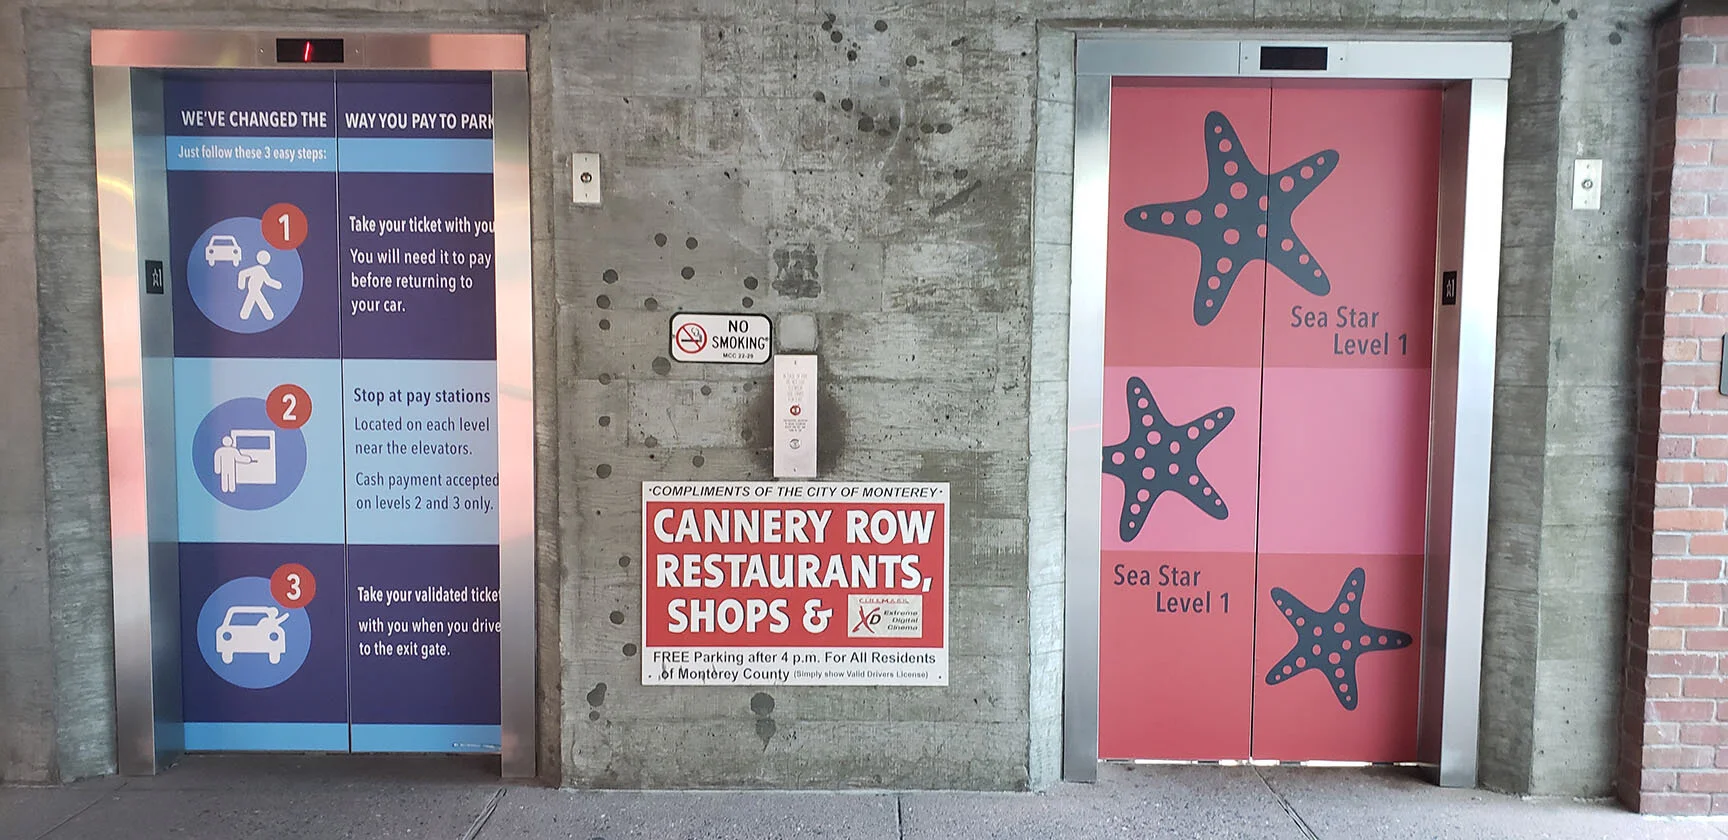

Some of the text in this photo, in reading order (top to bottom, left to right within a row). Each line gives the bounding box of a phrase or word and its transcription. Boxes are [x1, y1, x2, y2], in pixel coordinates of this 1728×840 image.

[304, 41, 311, 62] 1
[182, 111, 225, 127] WE'VE
[229, 111, 298, 128] CHANGED
[300, 112, 327, 128] THE
[345, 113, 376, 129] WAY
[379, 113, 407, 129] YOU
[412, 114, 439, 129] PAY
[440, 113, 457, 129] TO
[178, 146, 327, 162] Just follow these 3 easy steps:
[278, 214, 290, 240] 1
[349, 217, 495, 237] Take your ticket with you
[349, 249, 492, 269] You will need it to pay
[351, 274, 473, 292] before returning to
[351, 301, 405, 315] your car.
[1291, 305, 1379, 328] Sea Star
[728, 320, 749, 333] NO
[1334, 332, 1407, 355] Level 1
[354, 388, 491, 406] Stop at pay stations
[282, 394, 297, 421] 2
[355, 417, 490, 432] Located on each level
[355, 441, 473, 455] near the elevators.
[356, 472, 499, 490] Cash payment accepted
[652, 486, 939, 498] COMPLIMENTS OF THE CITY OF MONTEREY
[356, 495, 494, 514] on levels 2 and 3 only.
[653, 508, 936, 545] CANNERY ROW
[656, 553, 933, 593] RESTAURANTS,
[1113, 564, 1200, 586] Sea Star
[286, 574, 301, 601] 3
[357, 587, 383, 602] Take
[386, 590, 412, 606] your
[414, 587, 468, 602] validated
[1156, 591, 1229, 613] Level 1
[668, 598, 834, 634] SHOPS &
[852, 605, 881, 633] XD
[358, 618, 502, 637] with you when you drive
[359, 641, 451, 660] to the exit gate.
[653, 651, 936, 666] FREE Parking after 4 p.m. For All Residents
[661, 668, 675, 680] of
[678, 668, 738, 683] Monterey
[743, 668, 790, 683] County
[793, 670, 822, 679] (Simply
[896, 671, 929, 679] License)
